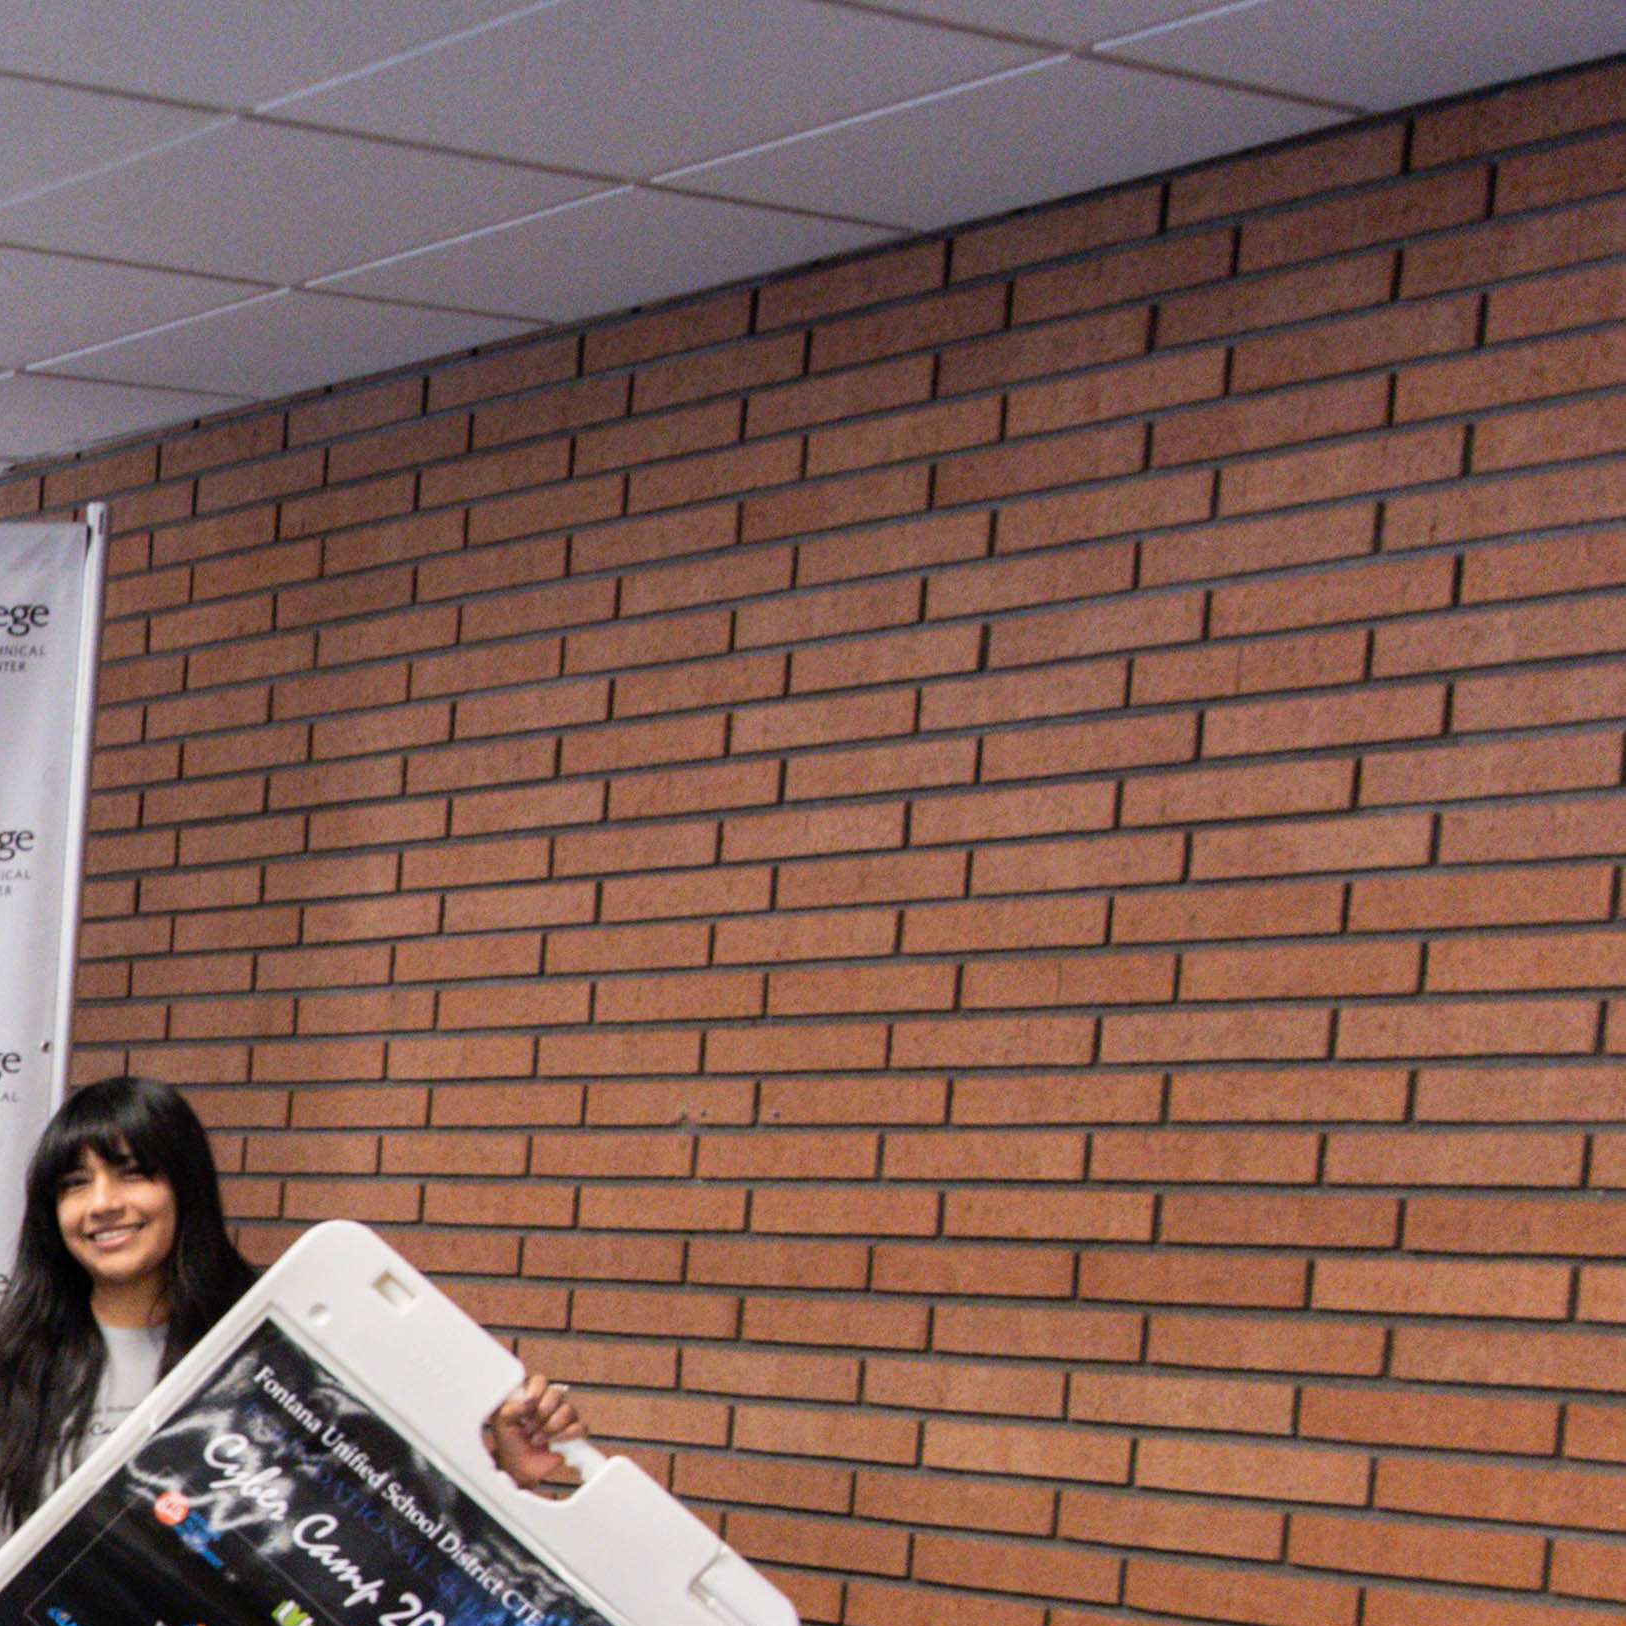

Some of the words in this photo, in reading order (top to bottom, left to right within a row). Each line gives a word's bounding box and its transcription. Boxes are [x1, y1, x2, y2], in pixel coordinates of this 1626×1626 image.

[203, 1433, 289, 1521] Cyber
[293, 1512, 385, 1608] Camp
[252, 1363, 322, 1434] Fontana
[321, 1422, 390, 1491] Unified
[386, 1476, 443, 1539] School
[435, 1525, 503, 1597] District
